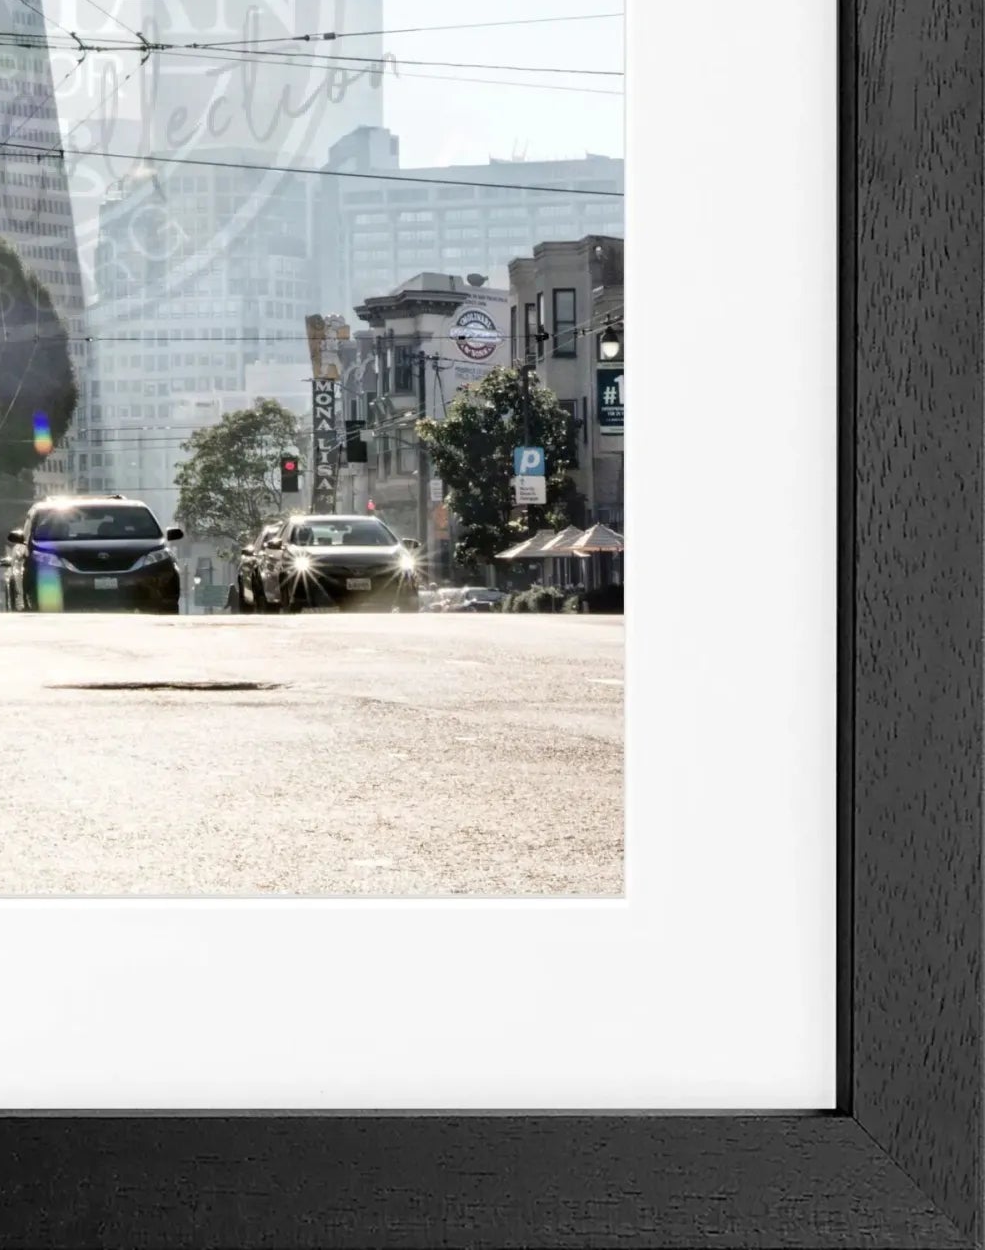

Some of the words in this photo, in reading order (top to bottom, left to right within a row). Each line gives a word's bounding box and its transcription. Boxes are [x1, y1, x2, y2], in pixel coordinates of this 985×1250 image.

[315, 381, 333, 431] MONA
[317, 438, 333, 490] LISA
[519, 449, 541, 473] P
